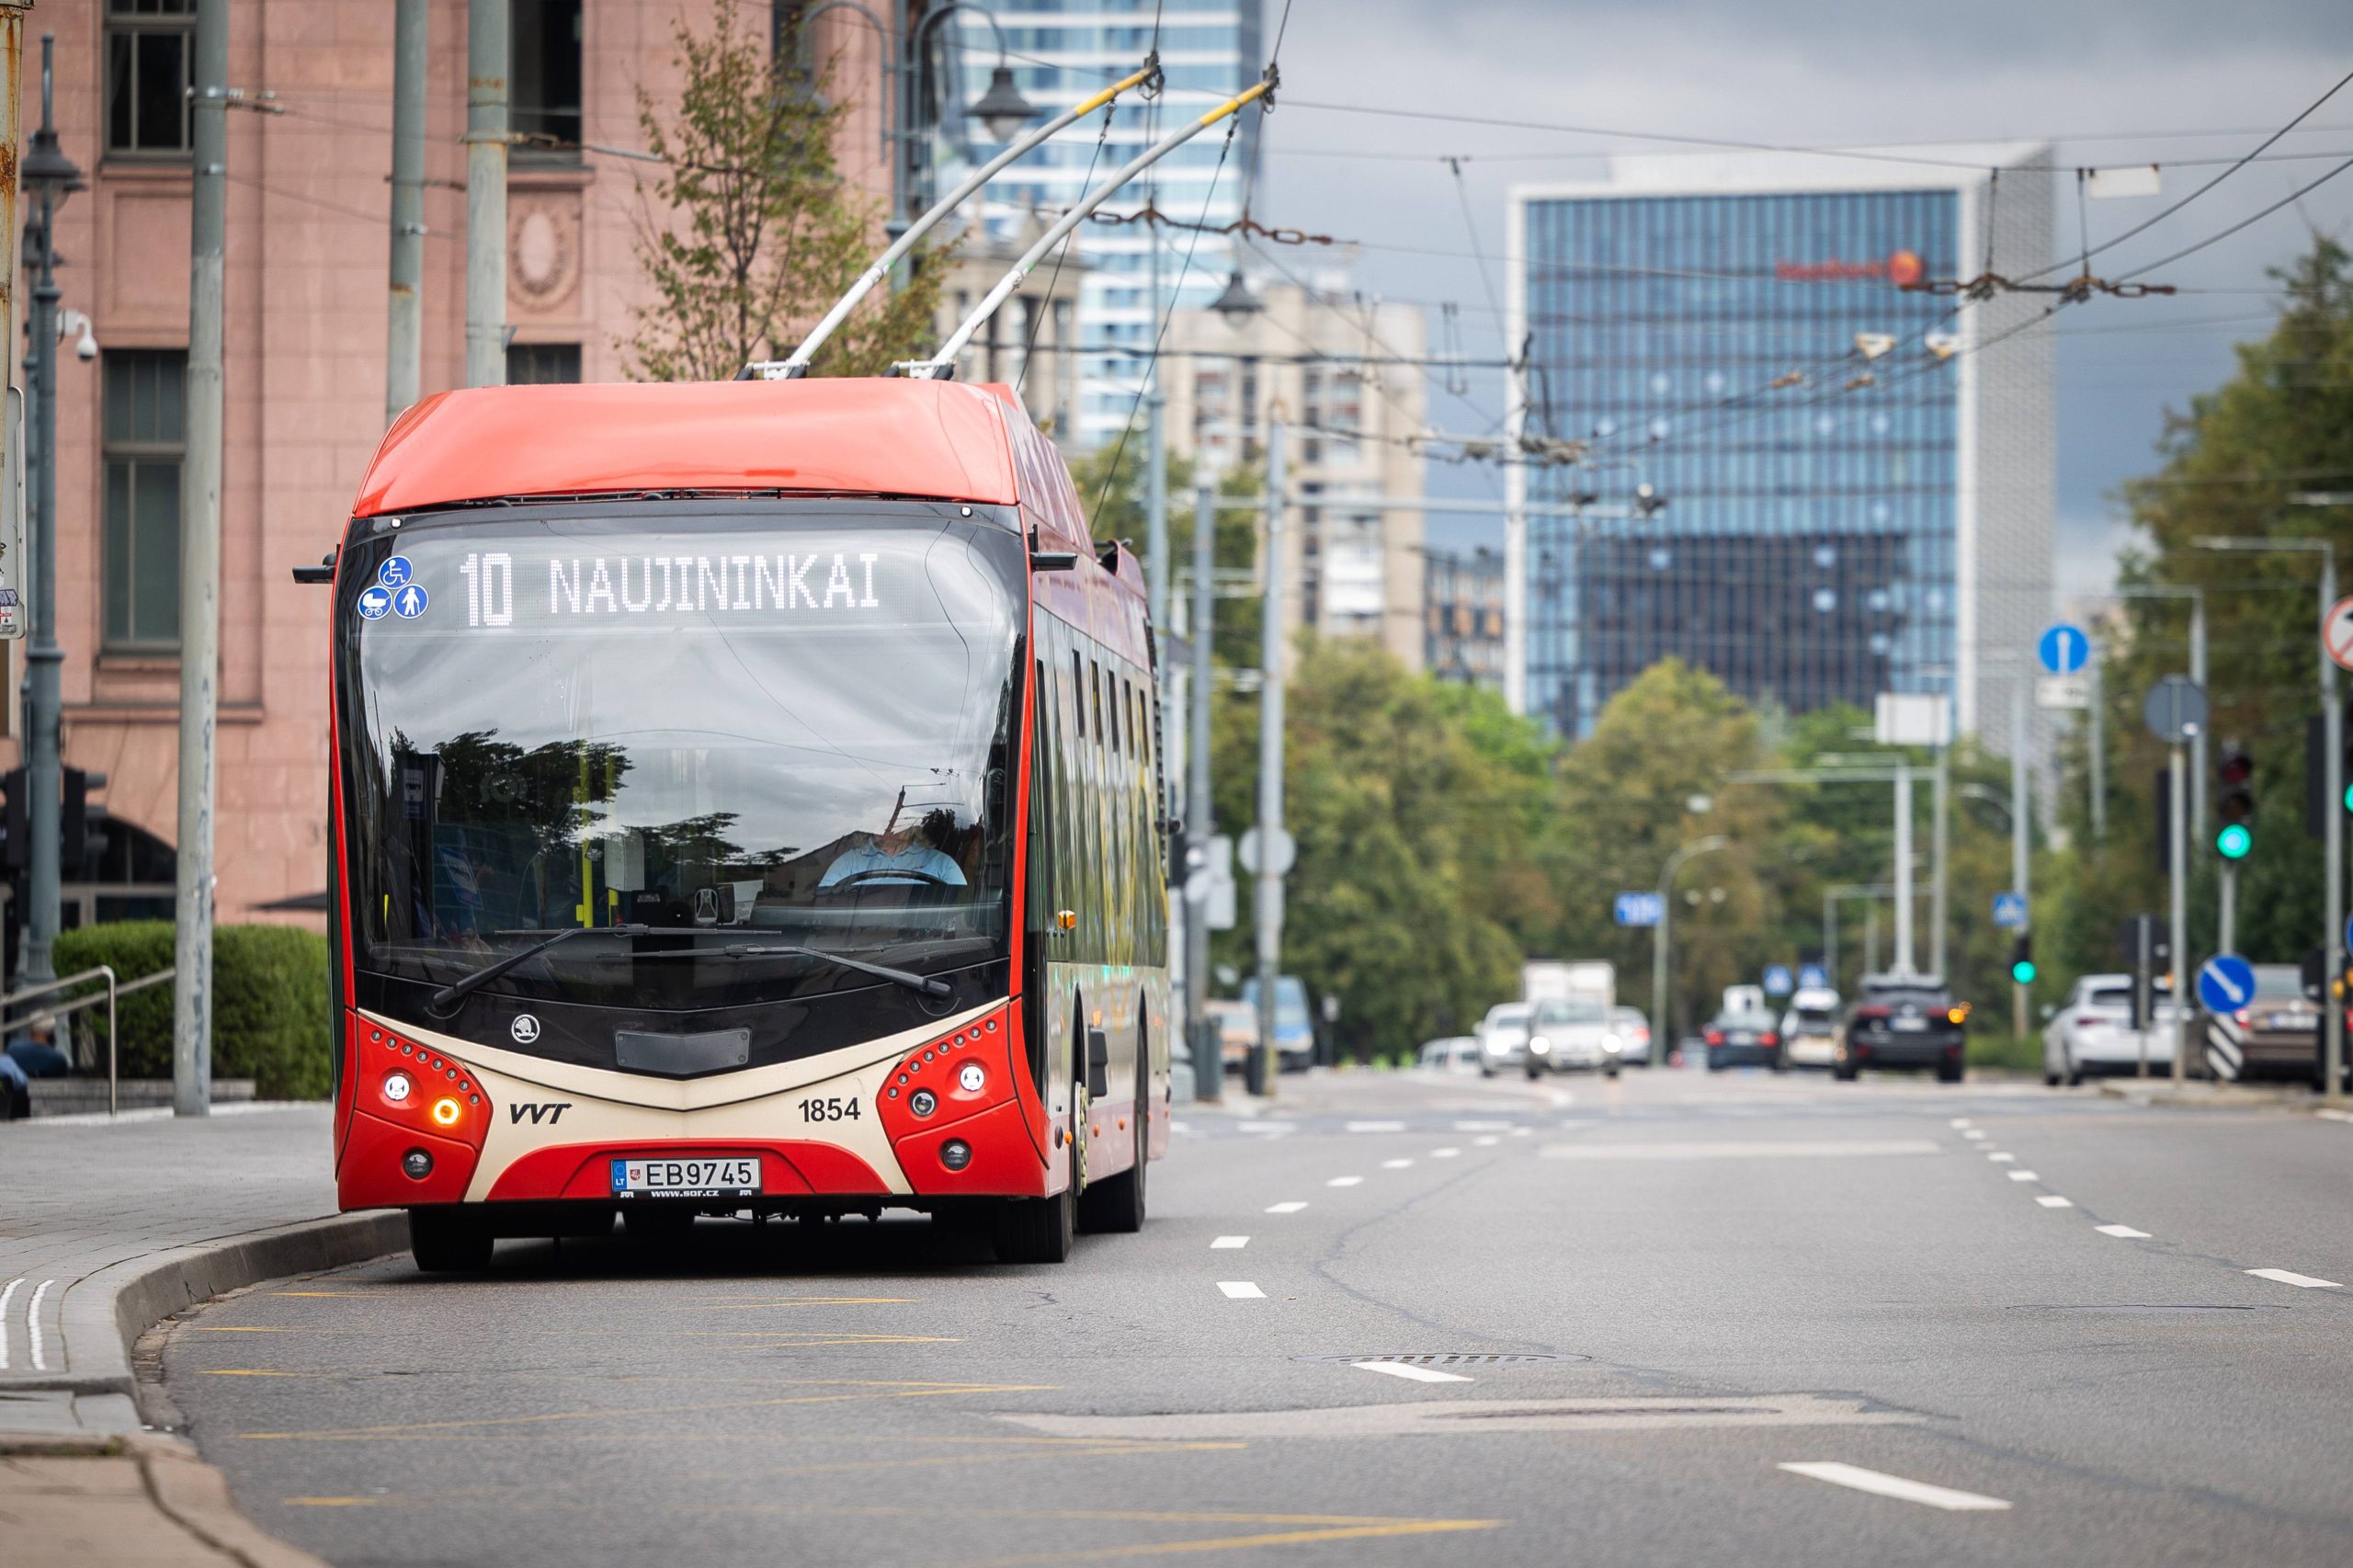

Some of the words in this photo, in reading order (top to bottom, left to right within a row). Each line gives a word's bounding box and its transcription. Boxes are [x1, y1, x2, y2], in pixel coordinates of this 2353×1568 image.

[460, 552, 512, 627] 10
[551, 553, 879, 614] NAUJININKAI
[510, 1103, 573, 1124] VVT
[799, 1097, 860, 1122] 1854
[646, 1163, 752, 1186] EB9745
